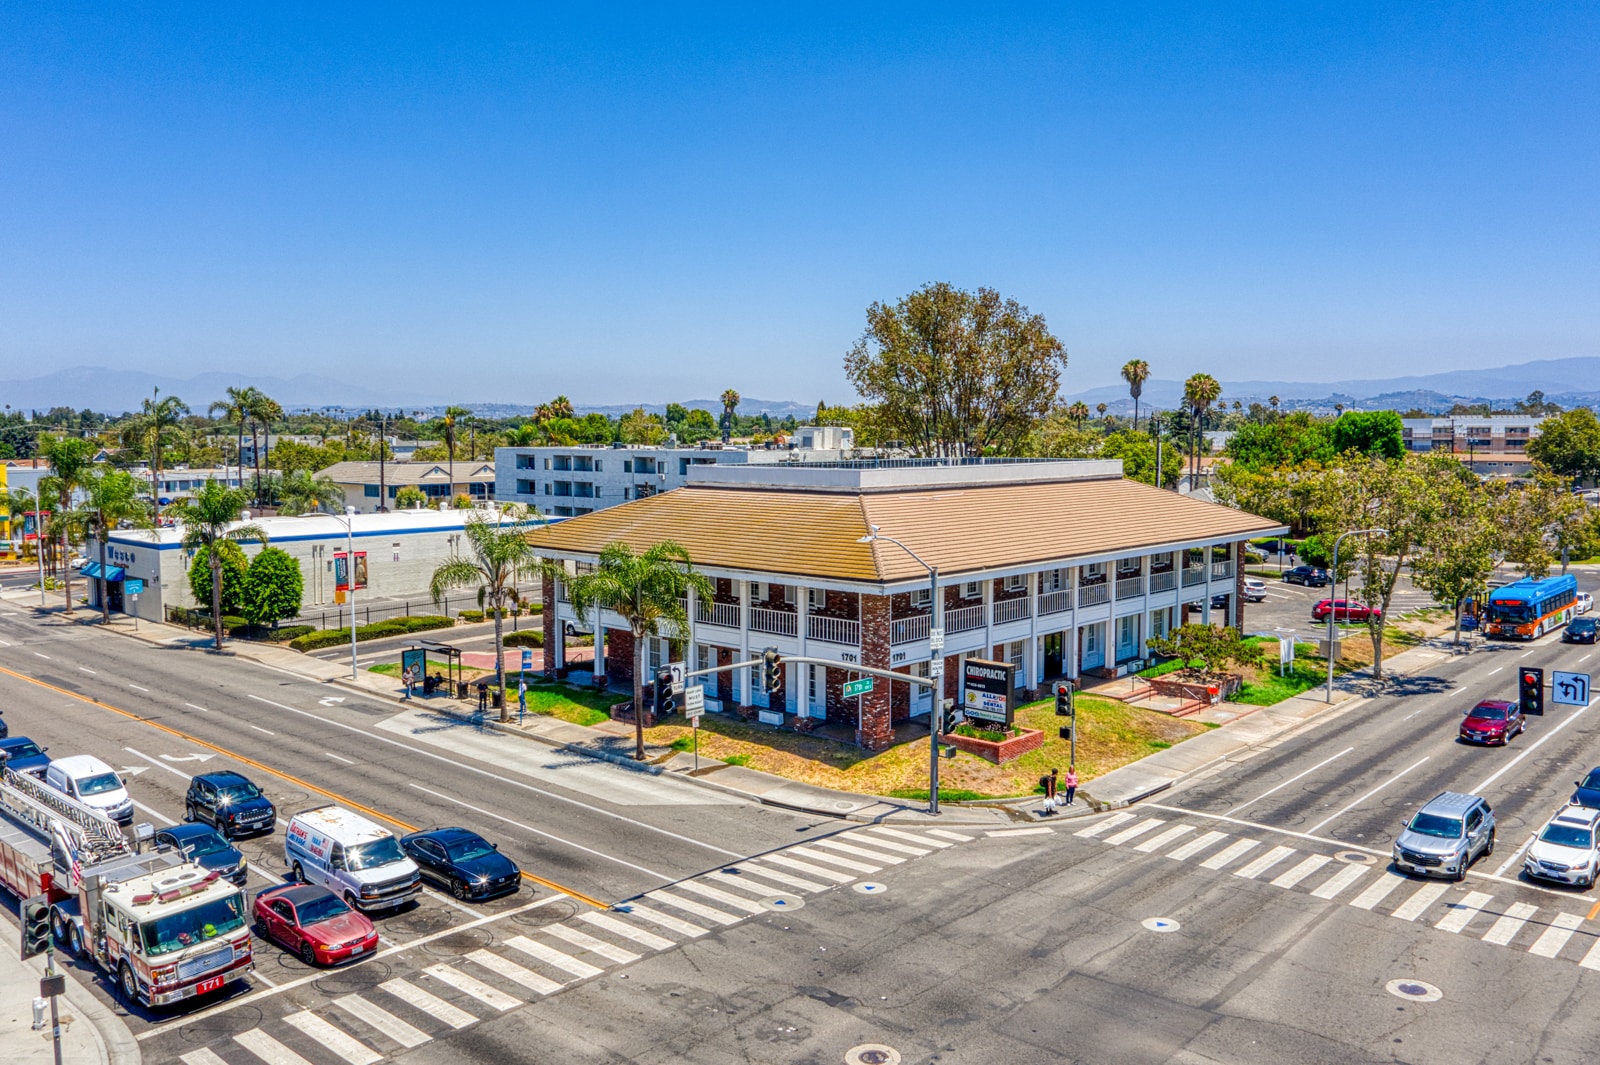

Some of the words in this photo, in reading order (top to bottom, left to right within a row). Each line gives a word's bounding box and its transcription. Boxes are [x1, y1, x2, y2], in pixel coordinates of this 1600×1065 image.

[841, 652, 857, 662] 1701
[892, 652, 906, 662] 1701
[966, 665, 1006, 681] CHIROPRACTIC
[983, 701, 1003, 709] DENTAL
[202, 979, 220, 990] T71
